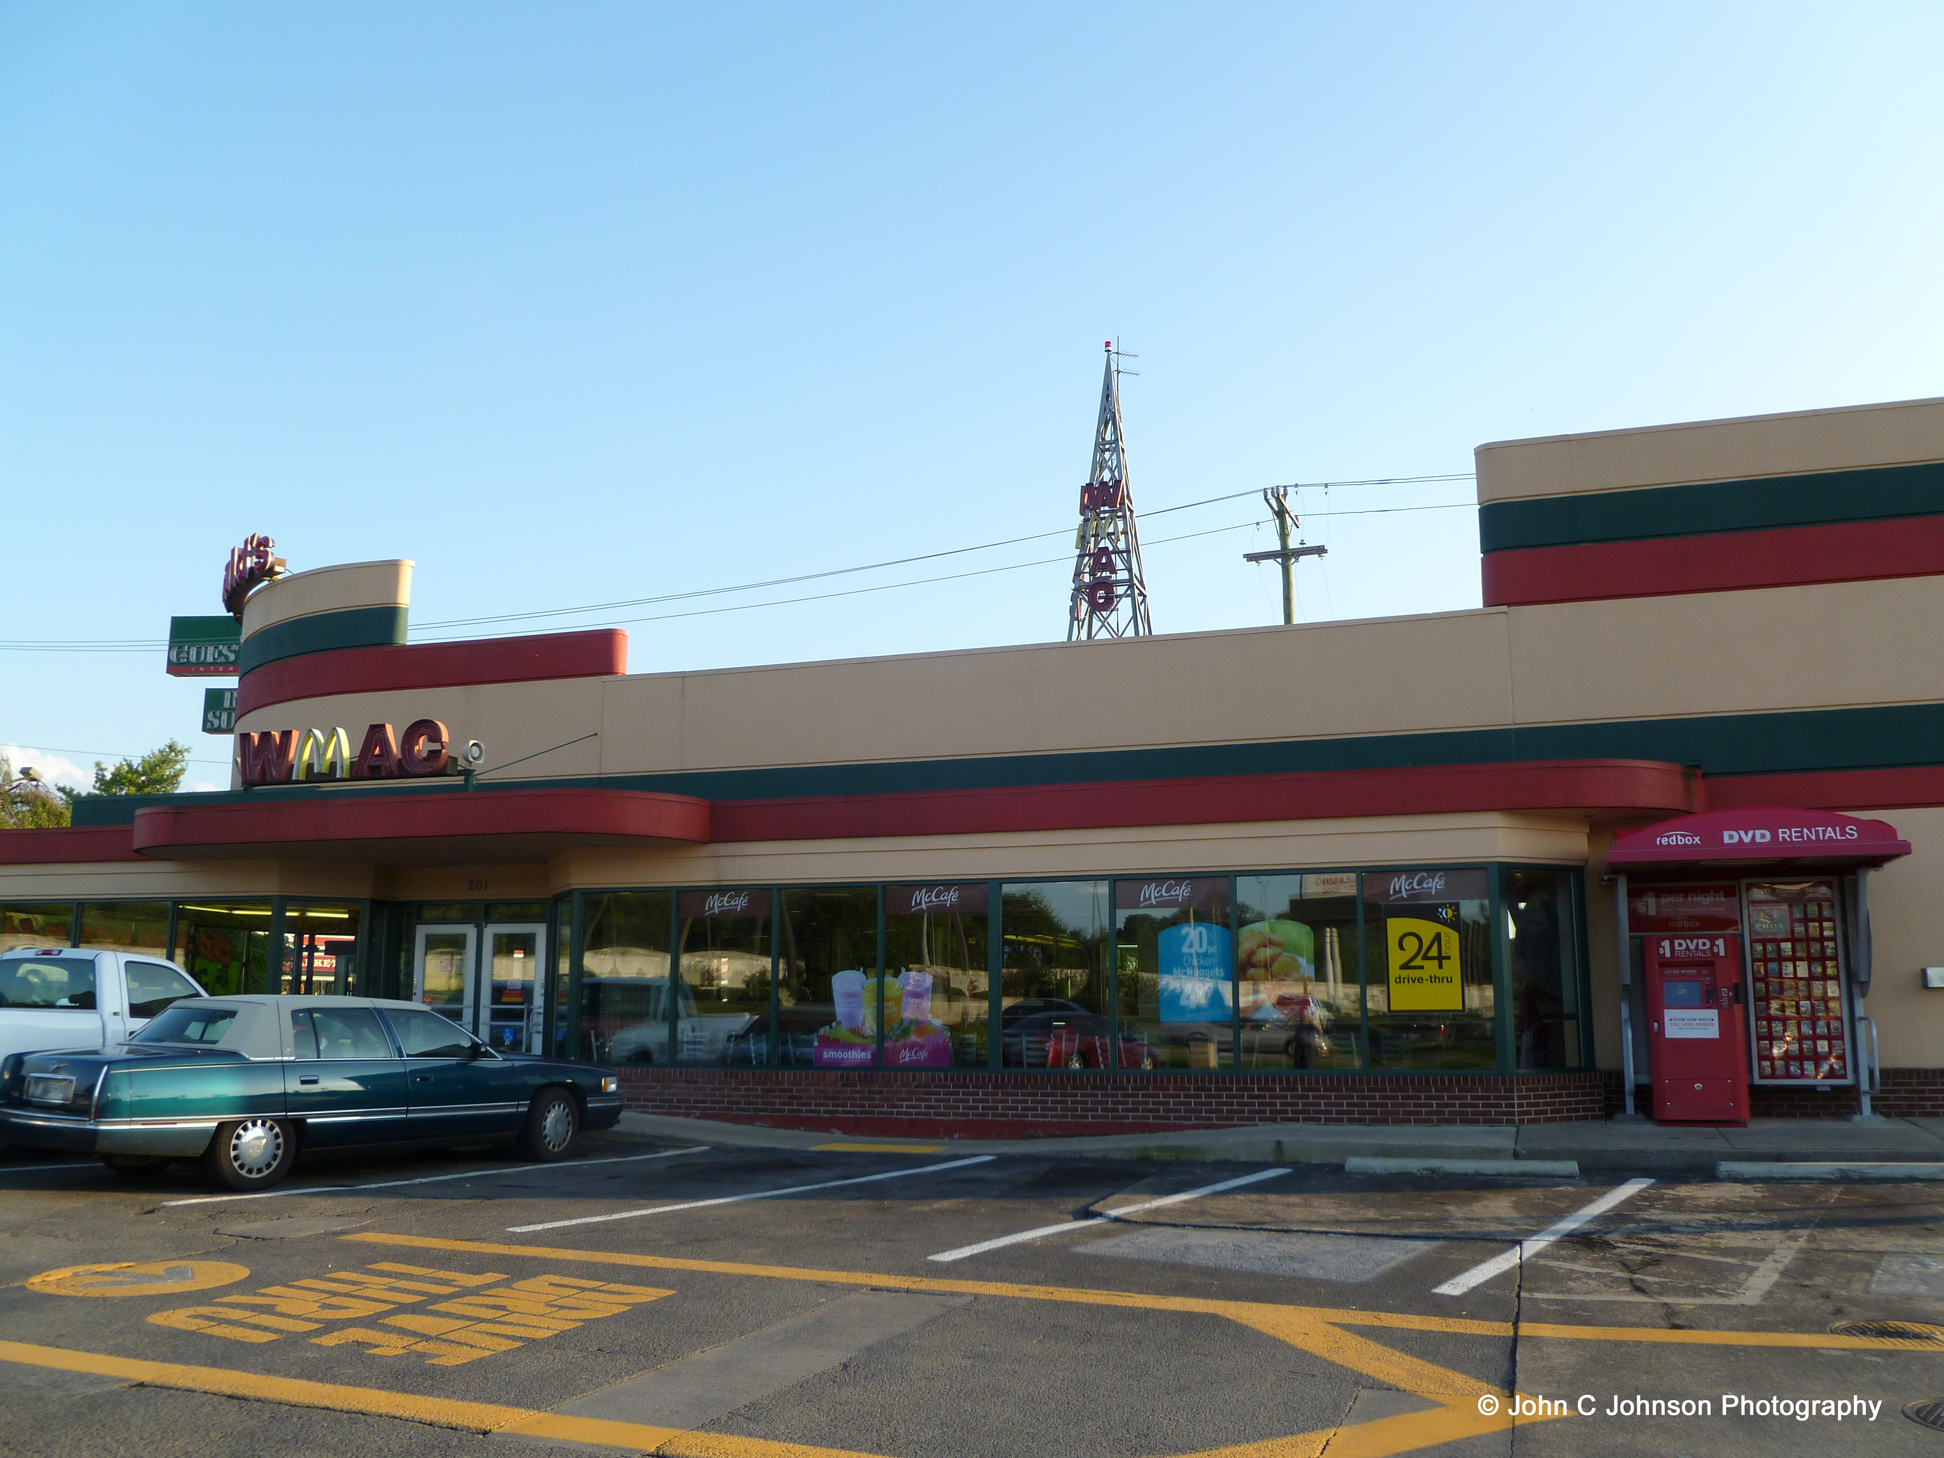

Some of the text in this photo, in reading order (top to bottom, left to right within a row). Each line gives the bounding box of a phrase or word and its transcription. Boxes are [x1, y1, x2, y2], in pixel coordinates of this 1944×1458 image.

[239, 718, 449, 786] WMAC
[1656, 825, 1858, 845] redbox DVD RENTALS
[468, 878, 488, 891] 201
[1139, 879, 1192, 907] McCafé
[1389, 872, 1446, 900] McCafé
[704, 891, 749, 916] McCafé
[910, 886, 959, 912] McCafé
[1637, 890, 1656, 916] $1
[1660, 893, 1685, 905] per
[1687, 890, 1725, 904] night
[1181, 926, 1217, 955] 20 pc
[1398, 931, 1451, 970] 24
[1443, 931, 1452, 955] hour
[1659, 938, 1725, 958] $1 DVD $1
[1183, 955, 1215, 966] Chicken
[1675, 949, 1711, 958] RENTALS
[1173, 966, 1225, 978] McNuggets
[1394, 974, 1453, 984] drive-thru
[823, 1049, 872, 1059] smoothies
